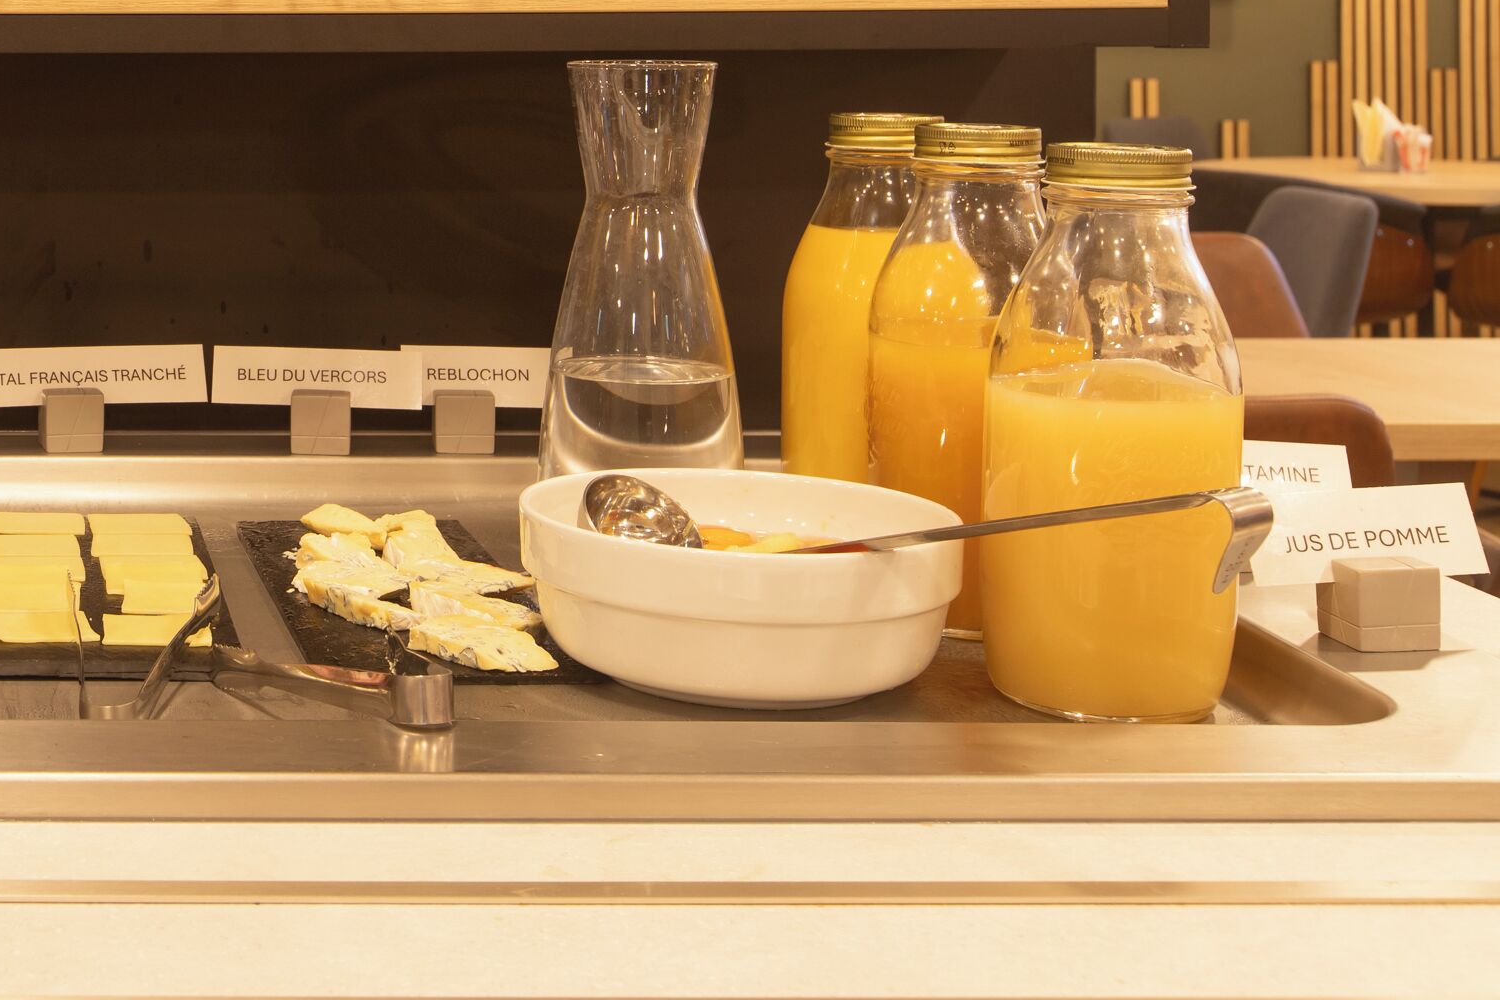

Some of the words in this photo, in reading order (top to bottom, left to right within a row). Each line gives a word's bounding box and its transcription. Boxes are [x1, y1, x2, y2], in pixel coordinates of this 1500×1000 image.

[29, 369, 109, 387] FRANÇAIS
[110, 364, 187, 383] TRANCHÉ
[237, 367, 278, 382] BLEU
[282, 368, 306, 382] DU
[309, 368, 387, 385] VERCORS
[426, 367, 530, 382] REBLOCHON
[1243, 464, 1321, 484] TAMINE
[1285, 533, 1324, 554] JUS
[1327, 531, 1360, 551] DE
[1363, 525, 1451, 549] POMME
